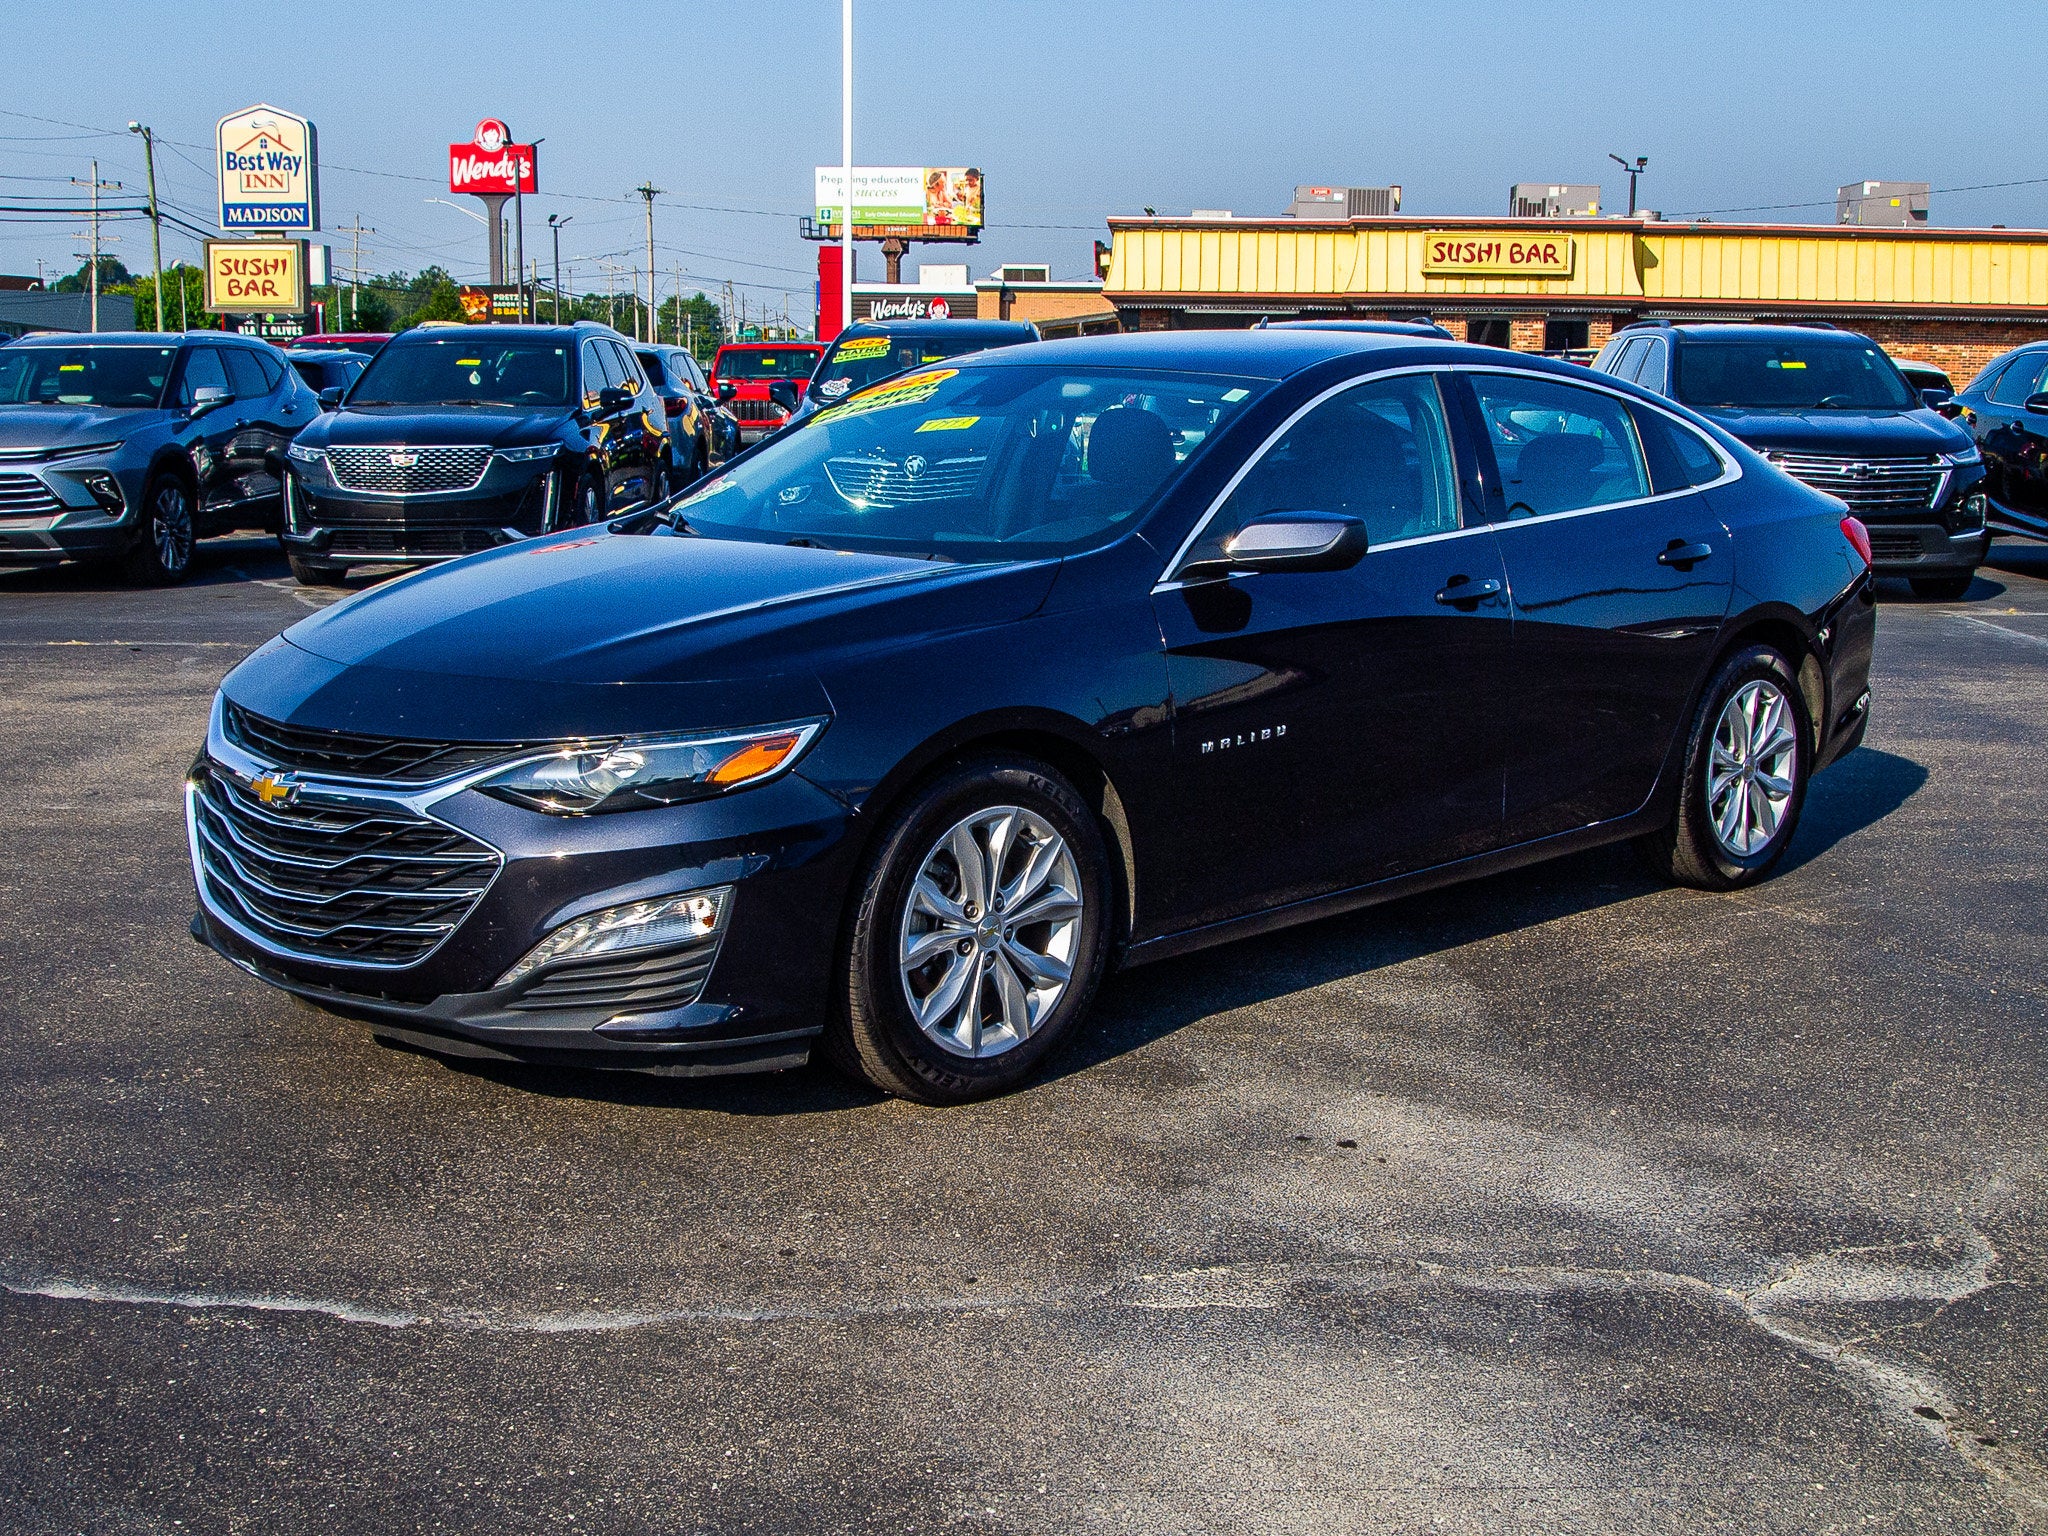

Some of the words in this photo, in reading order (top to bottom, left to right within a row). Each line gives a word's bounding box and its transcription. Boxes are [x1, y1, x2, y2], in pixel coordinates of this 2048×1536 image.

[226, 151, 265, 171] Best
[266, 151, 303, 177] Way
[452, 150, 531, 187] Wendy's
[245, 174, 285, 188] INN
[821, 175, 868, 186] Preping
[871, 175, 919, 184] educators
[227, 208, 304, 223] MADISON
[1432, 242, 1501, 264] SUSHI
[1509, 242, 1560, 264] BAR
[219, 258, 287, 276] SUSHI
[228, 278, 280, 297] BAR
[493, 293, 529, 302] PRETZL
[870, 296, 926, 320] Wendy's
[237, 325, 268, 336] BLAK
[270, 325, 304, 336] OLIVES
[1202, 724, 1287, 754] MALIBU
